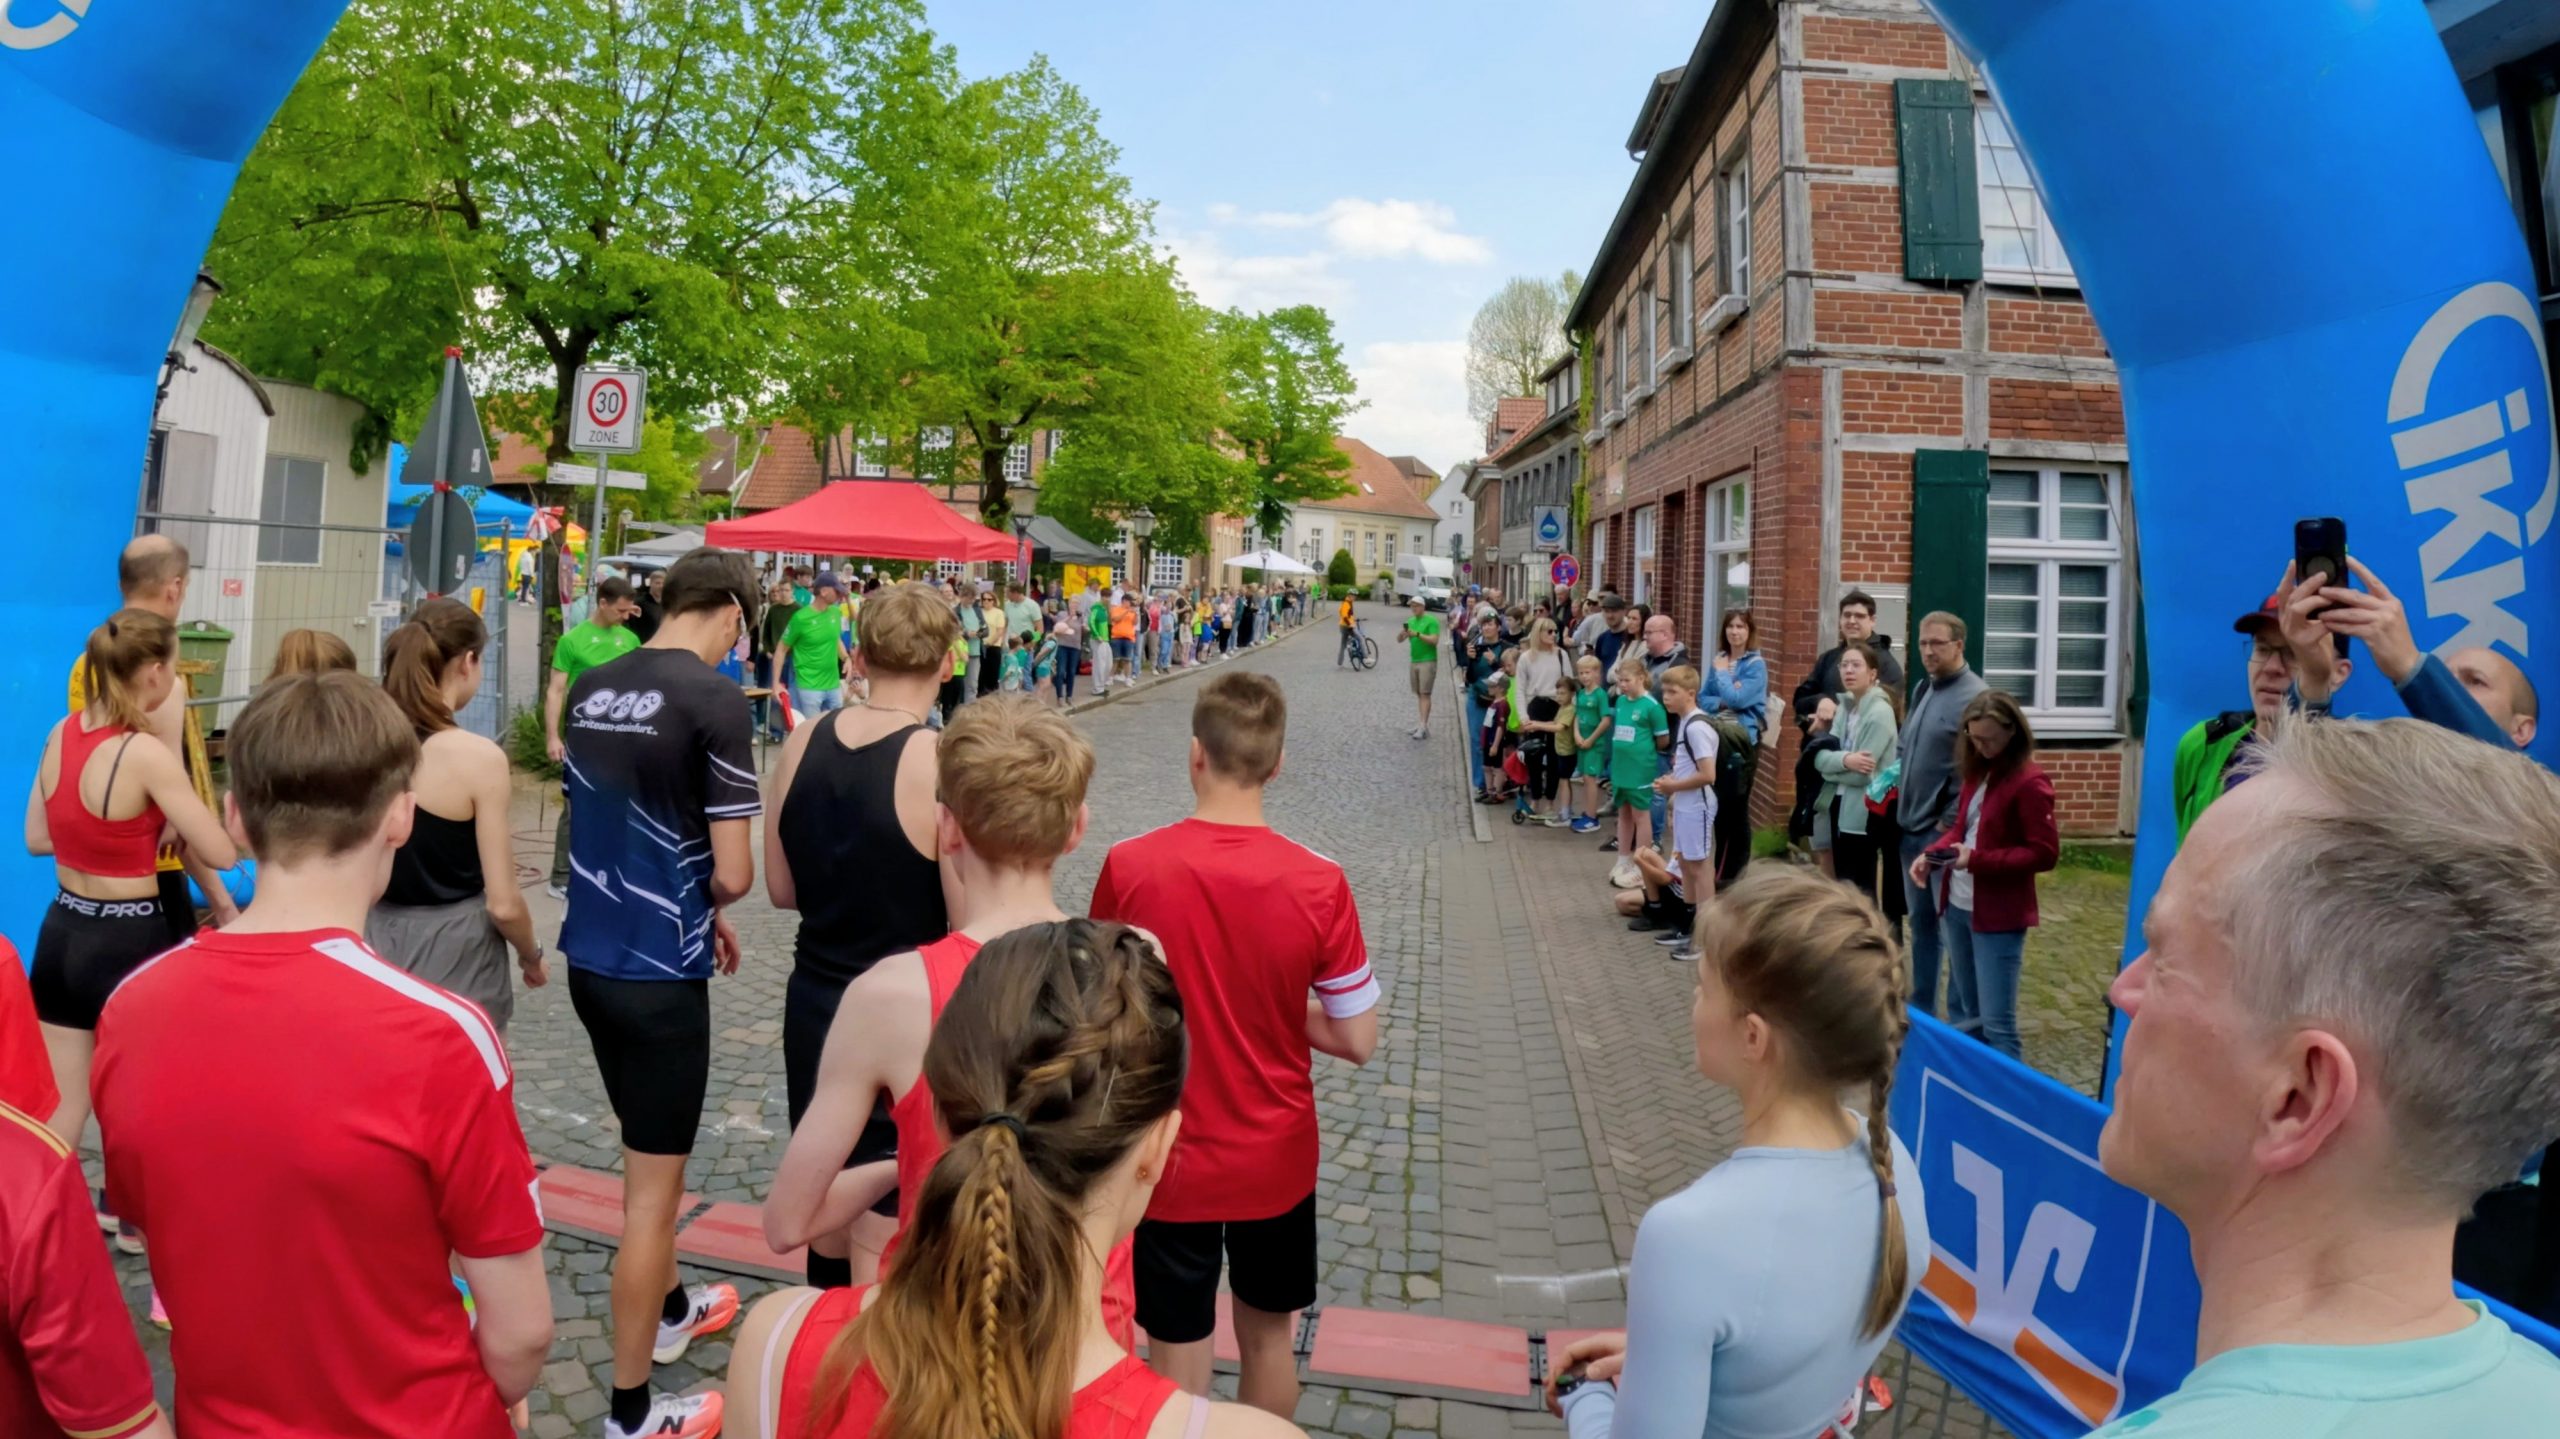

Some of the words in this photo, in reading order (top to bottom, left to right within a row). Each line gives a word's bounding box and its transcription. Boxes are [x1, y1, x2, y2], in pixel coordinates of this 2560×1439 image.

[595, 391, 619, 414] 30
[588, 430, 619, 444] ZONE
[100, 901, 154, 918] PRO
[694, 1302, 710, 1324] N
[657, 1415, 686, 1435] N
